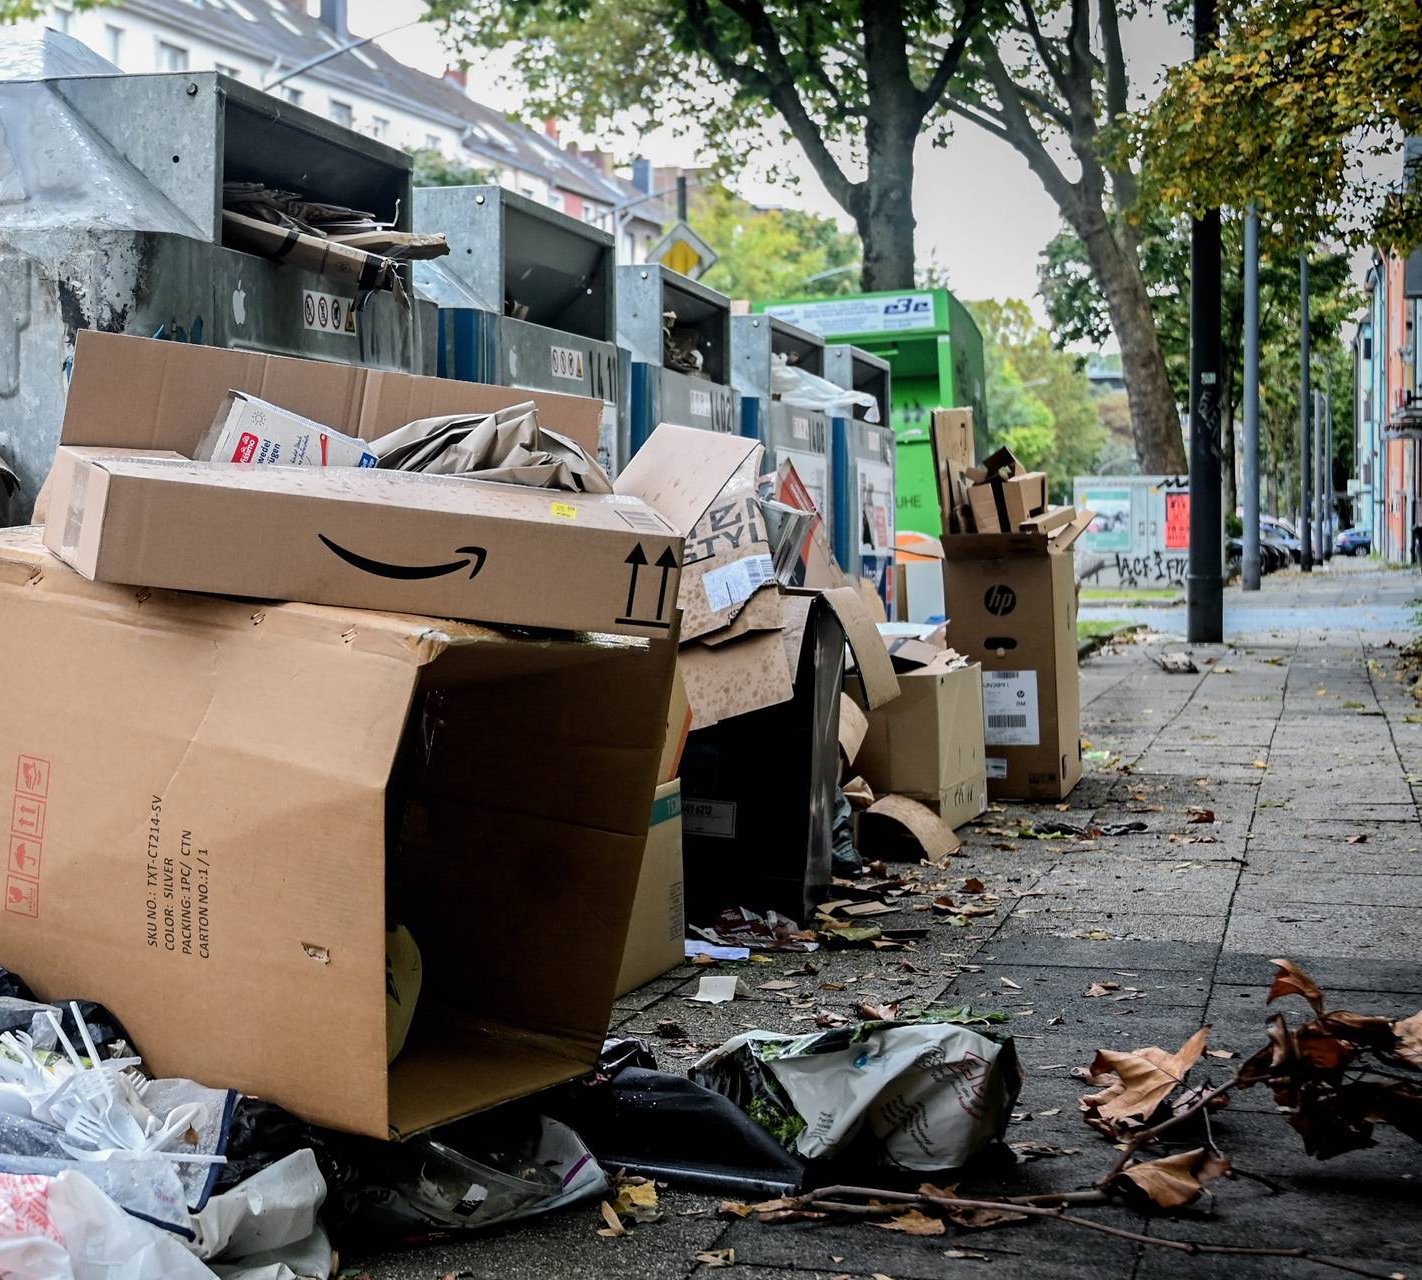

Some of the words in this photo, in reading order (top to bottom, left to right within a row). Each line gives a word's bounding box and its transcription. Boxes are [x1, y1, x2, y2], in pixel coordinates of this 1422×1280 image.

[989, 585, 1013, 616] hp
[147, 795, 163, 887] TXT-CT214-SV
[181, 830, 192, 857] CTN
[164, 857, 174, 899] SILVER
[180, 861, 193, 893] 1PC/
[148, 923, 158, 948] SKU
[164, 905, 175, 951] COLOR:
[181, 896, 192, 955] PACKING:
[199, 907, 210, 959] CARTON
